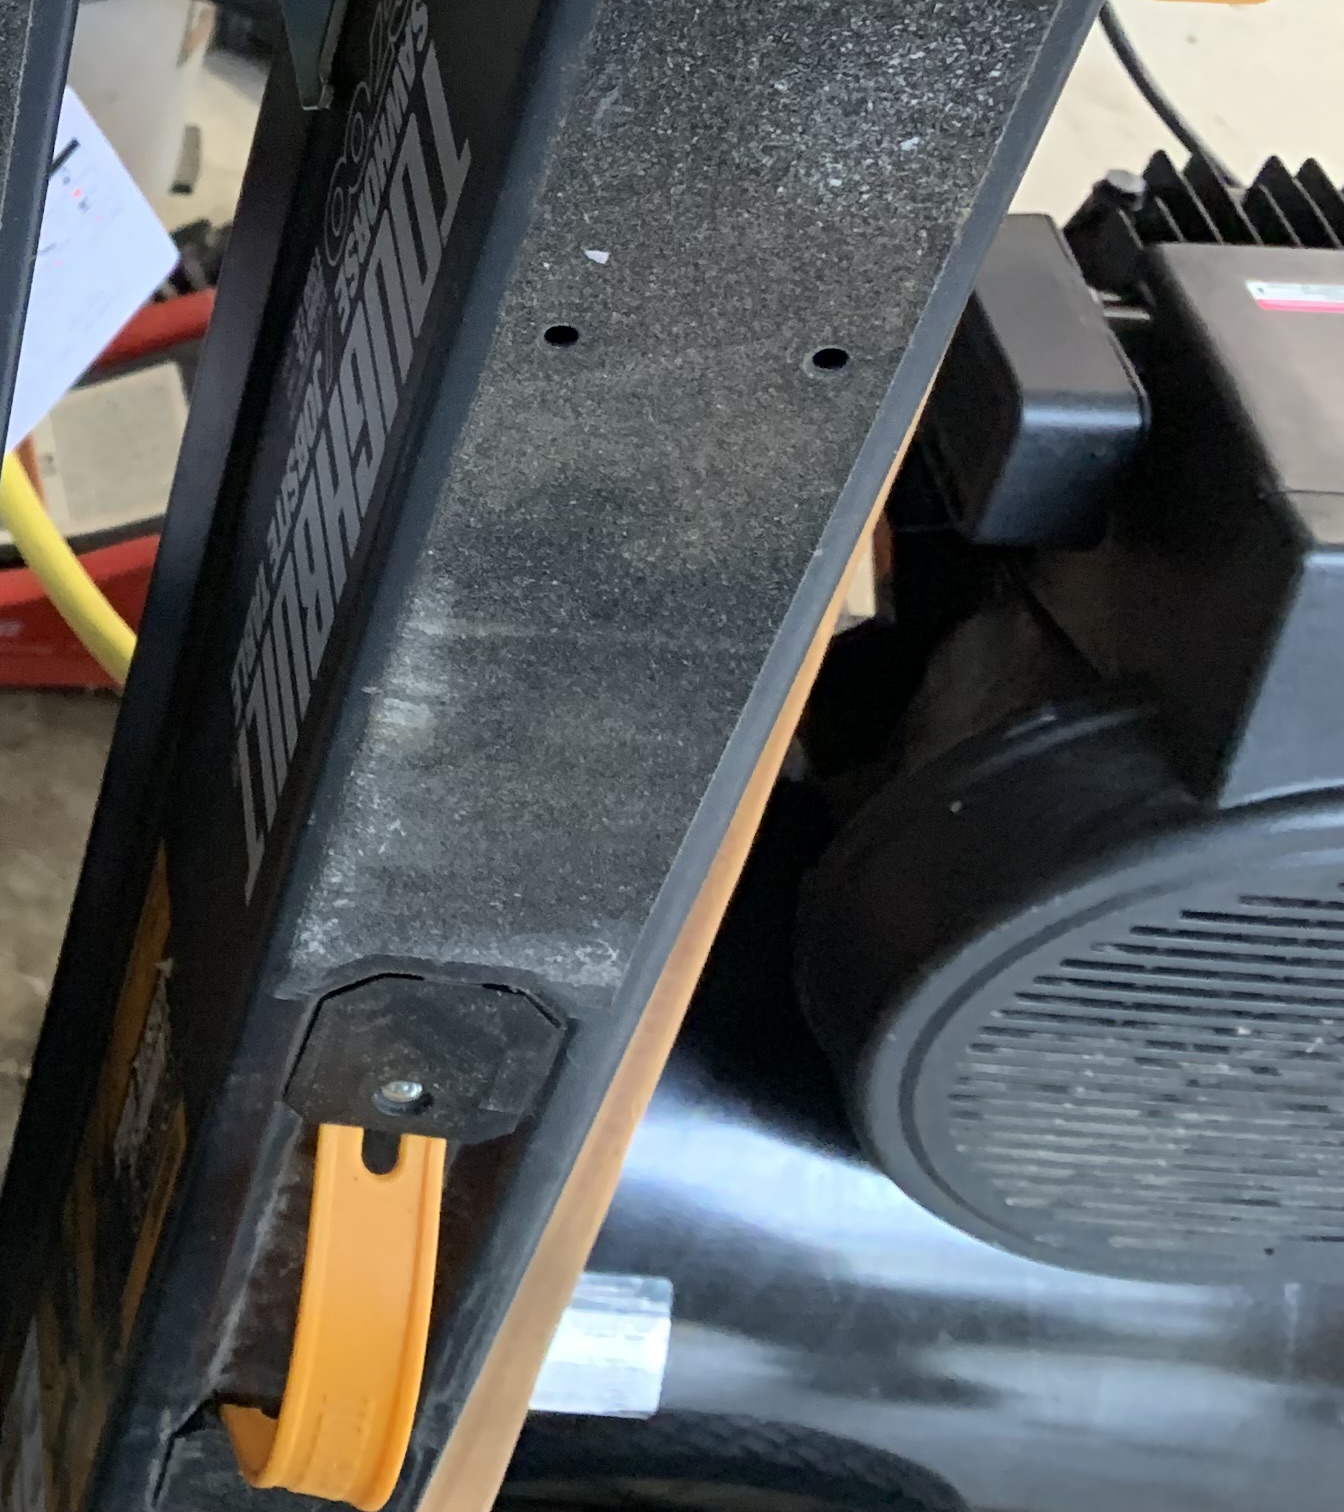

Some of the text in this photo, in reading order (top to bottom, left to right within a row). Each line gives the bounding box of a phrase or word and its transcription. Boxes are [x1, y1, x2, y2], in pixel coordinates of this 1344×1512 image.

[238, 40, 472, 905] TOUGHBUILT
[266, 349, 323, 578] JOBSITE
[231, 561, 266, 728] TABLE
